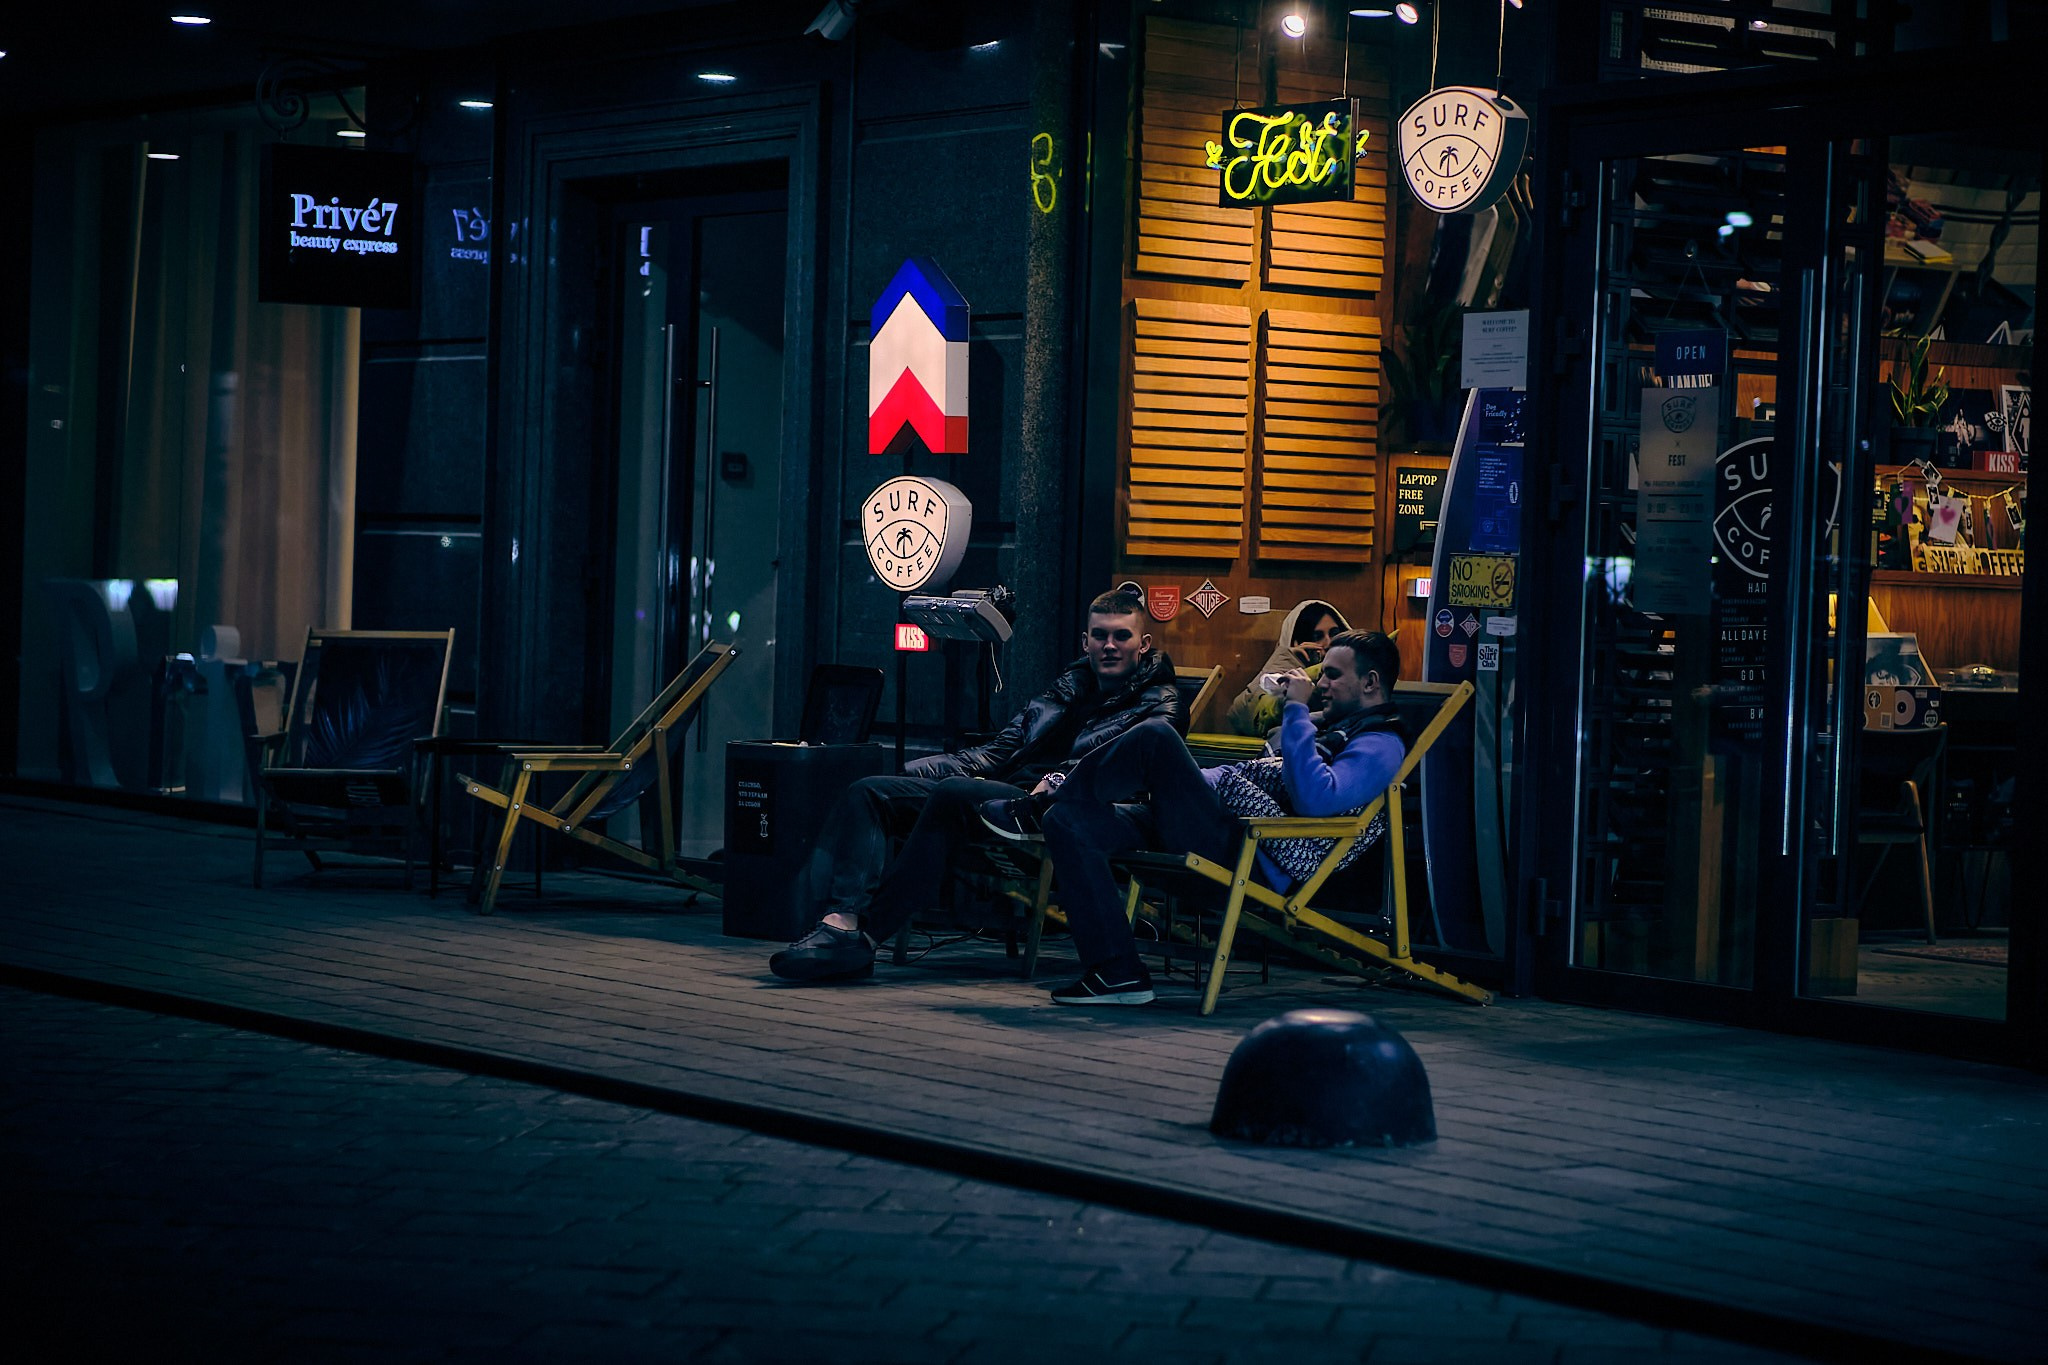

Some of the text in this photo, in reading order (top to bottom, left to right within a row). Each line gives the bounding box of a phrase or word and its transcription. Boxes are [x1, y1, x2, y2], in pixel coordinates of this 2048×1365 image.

[1415, 103, 1490, 137] SURF
[1414, 167, 1483, 200] COFFEE
[290, 193, 399, 236] Privé7
[290, 231, 399, 255] beauty express
[1676, 345, 1706, 360] OPEN
[1668, 454, 1687, 466] FEST
[1988, 453, 2015, 474] KISS
[1399, 473, 1438, 486] LAPTOP
[1724, 453, 1768, 491] SU
[1398, 489, 1424, 500] FREE
[873, 490, 936, 522] SURF
[1398, 504, 1425, 516] ZONE
[1727, 526, 1771, 565] COF
[877, 544, 933, 578] COFFEE
[1452, 561, 1473, 581] NO
[1930, 549, 1967, 575] SURF
[1451, 584, 1490, 599] SMOKING
[1196, 592, 1221, 613] HOUSE
[898, 626, 925, 649] KISS
[1478, 648, 1498, 661] Surf
[1485, 645, 1494, 653] The
[1481, 660, 1496, 668] Club
